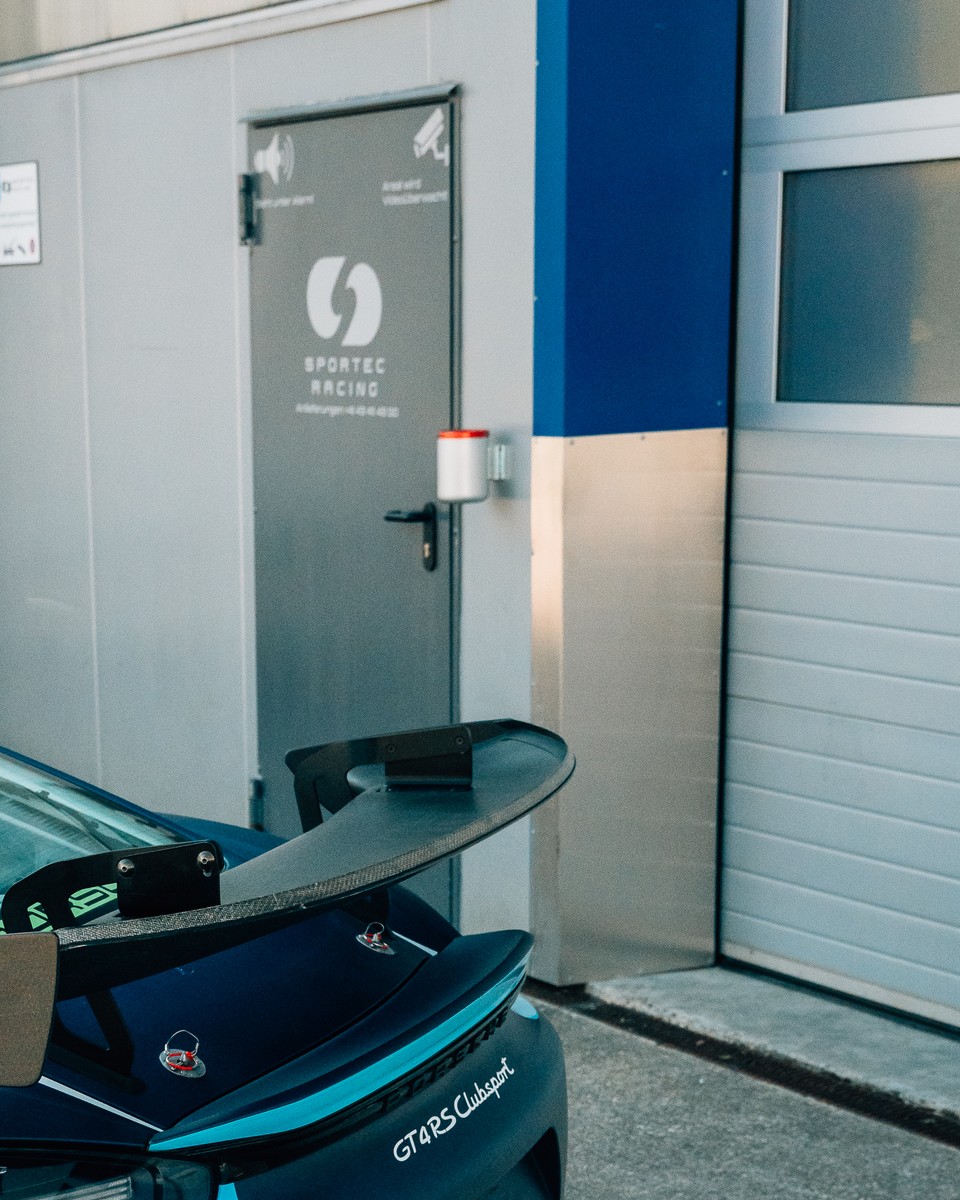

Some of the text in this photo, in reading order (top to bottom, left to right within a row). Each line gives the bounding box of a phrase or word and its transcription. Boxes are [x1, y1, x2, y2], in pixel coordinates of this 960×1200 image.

[304, 356, 386, 374] SPORTEC
[310, 379, 378, 398] RACING
[453, 1057, 515, 1119] Clubsport
